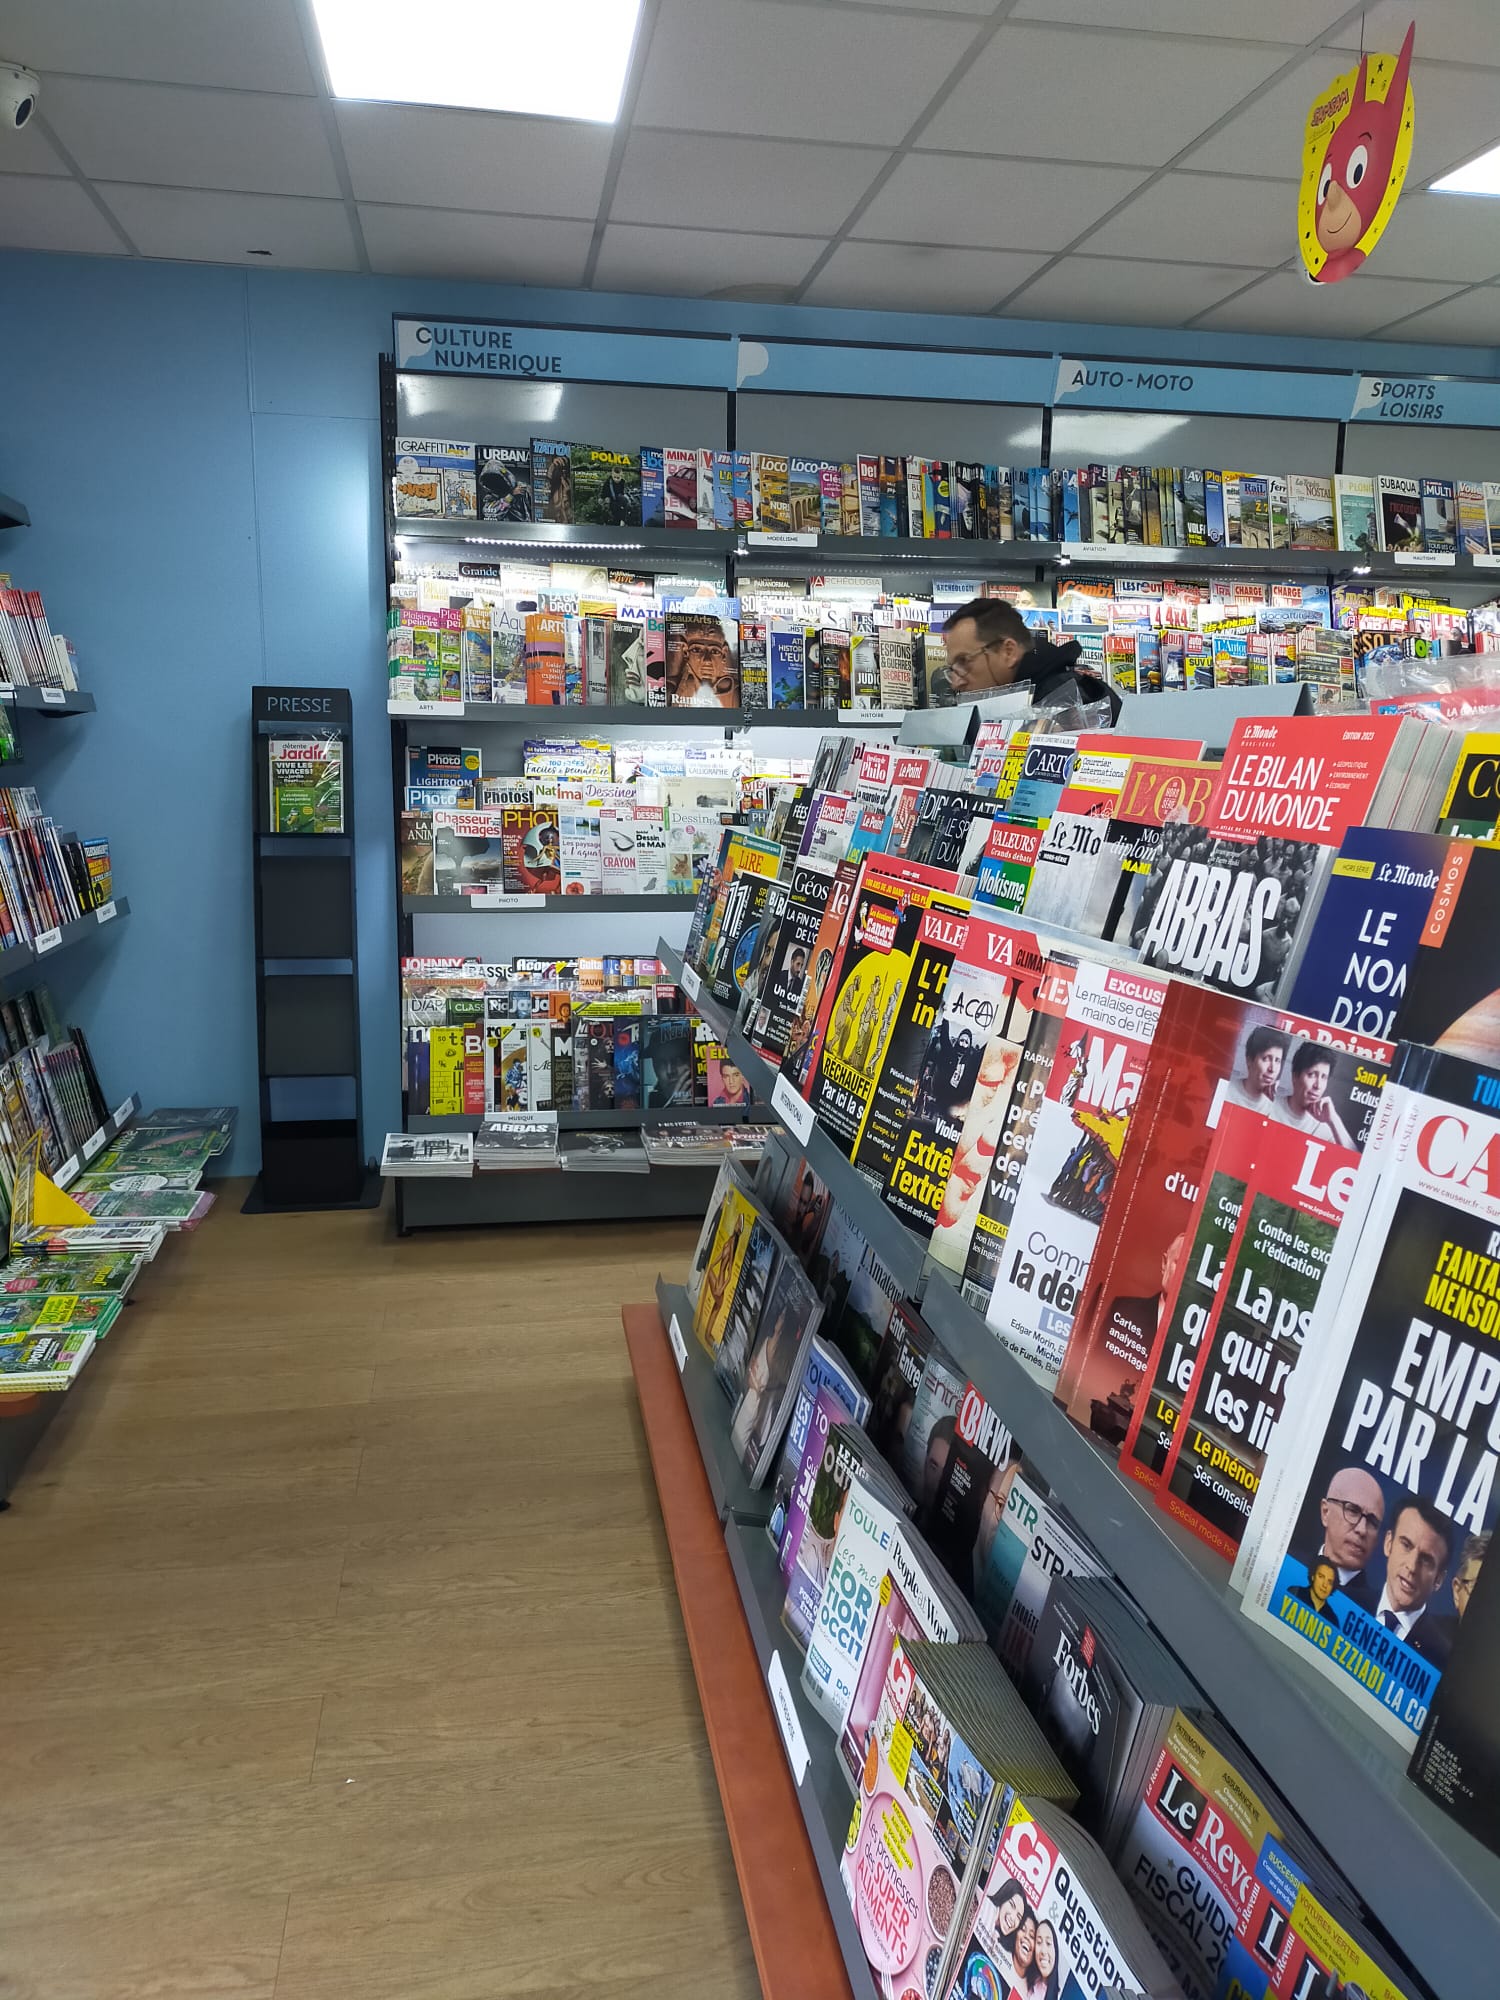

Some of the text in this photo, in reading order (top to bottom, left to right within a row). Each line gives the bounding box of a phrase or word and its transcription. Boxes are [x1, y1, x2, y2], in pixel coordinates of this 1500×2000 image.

[415, 326, 513, 350] CULTURE
[434, 350, 562, 378] NUMERIQUE
[1371, 381, 1437, 400] SPORTS
[1379, 402, 1445, 420] LOISIRS
[591, 451, 631, 465] POLKA
[1235, 586, 1262, 597] CHARGE
[1273, 587, 1301, 598] CHARGE
[881, 643, 911, 659] ESPIONS
[267, 696, 332, 713] PRESSE
[1243, 725, 1279, 740] Le Monde
[1342, 730, 1375, 741] ÉDITION 2023
[428, 754, 460, 765] Photo
[861, 761, 887, 781] Philo
[1227, 754, 1325, 792] LE BILAN
[416, 778, 473, 787] LIGHTROOM
[584, 785, 636, 797] Dessiner
[410, 790, 457, 805] Photo
[1219, 789, 1341, 832] DU MONDE
[435, 812, 491, 825] Chasseur
[636, 811, 663, 820] DESSIN
[456, 824, 500, 838] images
[636, 834, 660, 842] Dessin
[991, 829, 1038, 853] VALEURS
[603, 857, 636, 868] CRAYON
[990, 847, 1011, 860] Grands
[1375, 862, 1440, 890] Le Monde
[1429, 854, 1464, 935] COSMOS
[797, 911, 810, 925] FIN
[1140, 858, 1283, 989] ABBAS
[1357, 909, 1398, 947] LE
[1088, 987, 1134, 1014] malaise
[1081, 1006, 1135, 1029] mains de
[1355, 1067, 1379, 1087] Sam
[821, 1079, 857, 1114] Par ici la
[1418, 1178, 1481, 1210] www.causeur.fr
[1258, 1218, 1310, 1253] Contre les
[1235, 1267, 1275, 1324] La
[1009, 1318, 1033, 1340] Edgar
[1112, 1311, 1145, 1339] Cartes,
[1108, 1327, 1151, 1359] analyses,
[1221, 1330, 1271, 1386] qui
[1204, 1372, 1249, 1434] les
[1342, 1377, 1500, 1538] PAR LA
[1193, 1464, 1252, 1518] Ses conseils
[893, 1540, 921, 1594] People
[1278, 1594, 1405, 1713] YANNIS EZZIADI LA
[1341, 1609, 1432, 1699] GÉNÉRATION
[1052, 1629, 1102, 1737] Forbes
[1150, 1749, 1168, 1785] Revenu
[1158, 1768, 1198, 1830] Le
[867, 1810, 880, 1836] Les
[875, 1840, 920, 1921] promesses
[863, 1842, 876, 1874] des
[872, 1860, 911, 1932] SUPER
[856, 1857, 908, 1966] ALIMENTS
[1134, 1853, 1205, 1951] FISCAL
[1176, 1865, 1236, 1954] GUIDE
[1300, 1893, 1332, 1936] VOITURES
[1332, 1930, 1361, 1967] VERTES
[1271, 1931, 1296, 1989] Le Revenu
